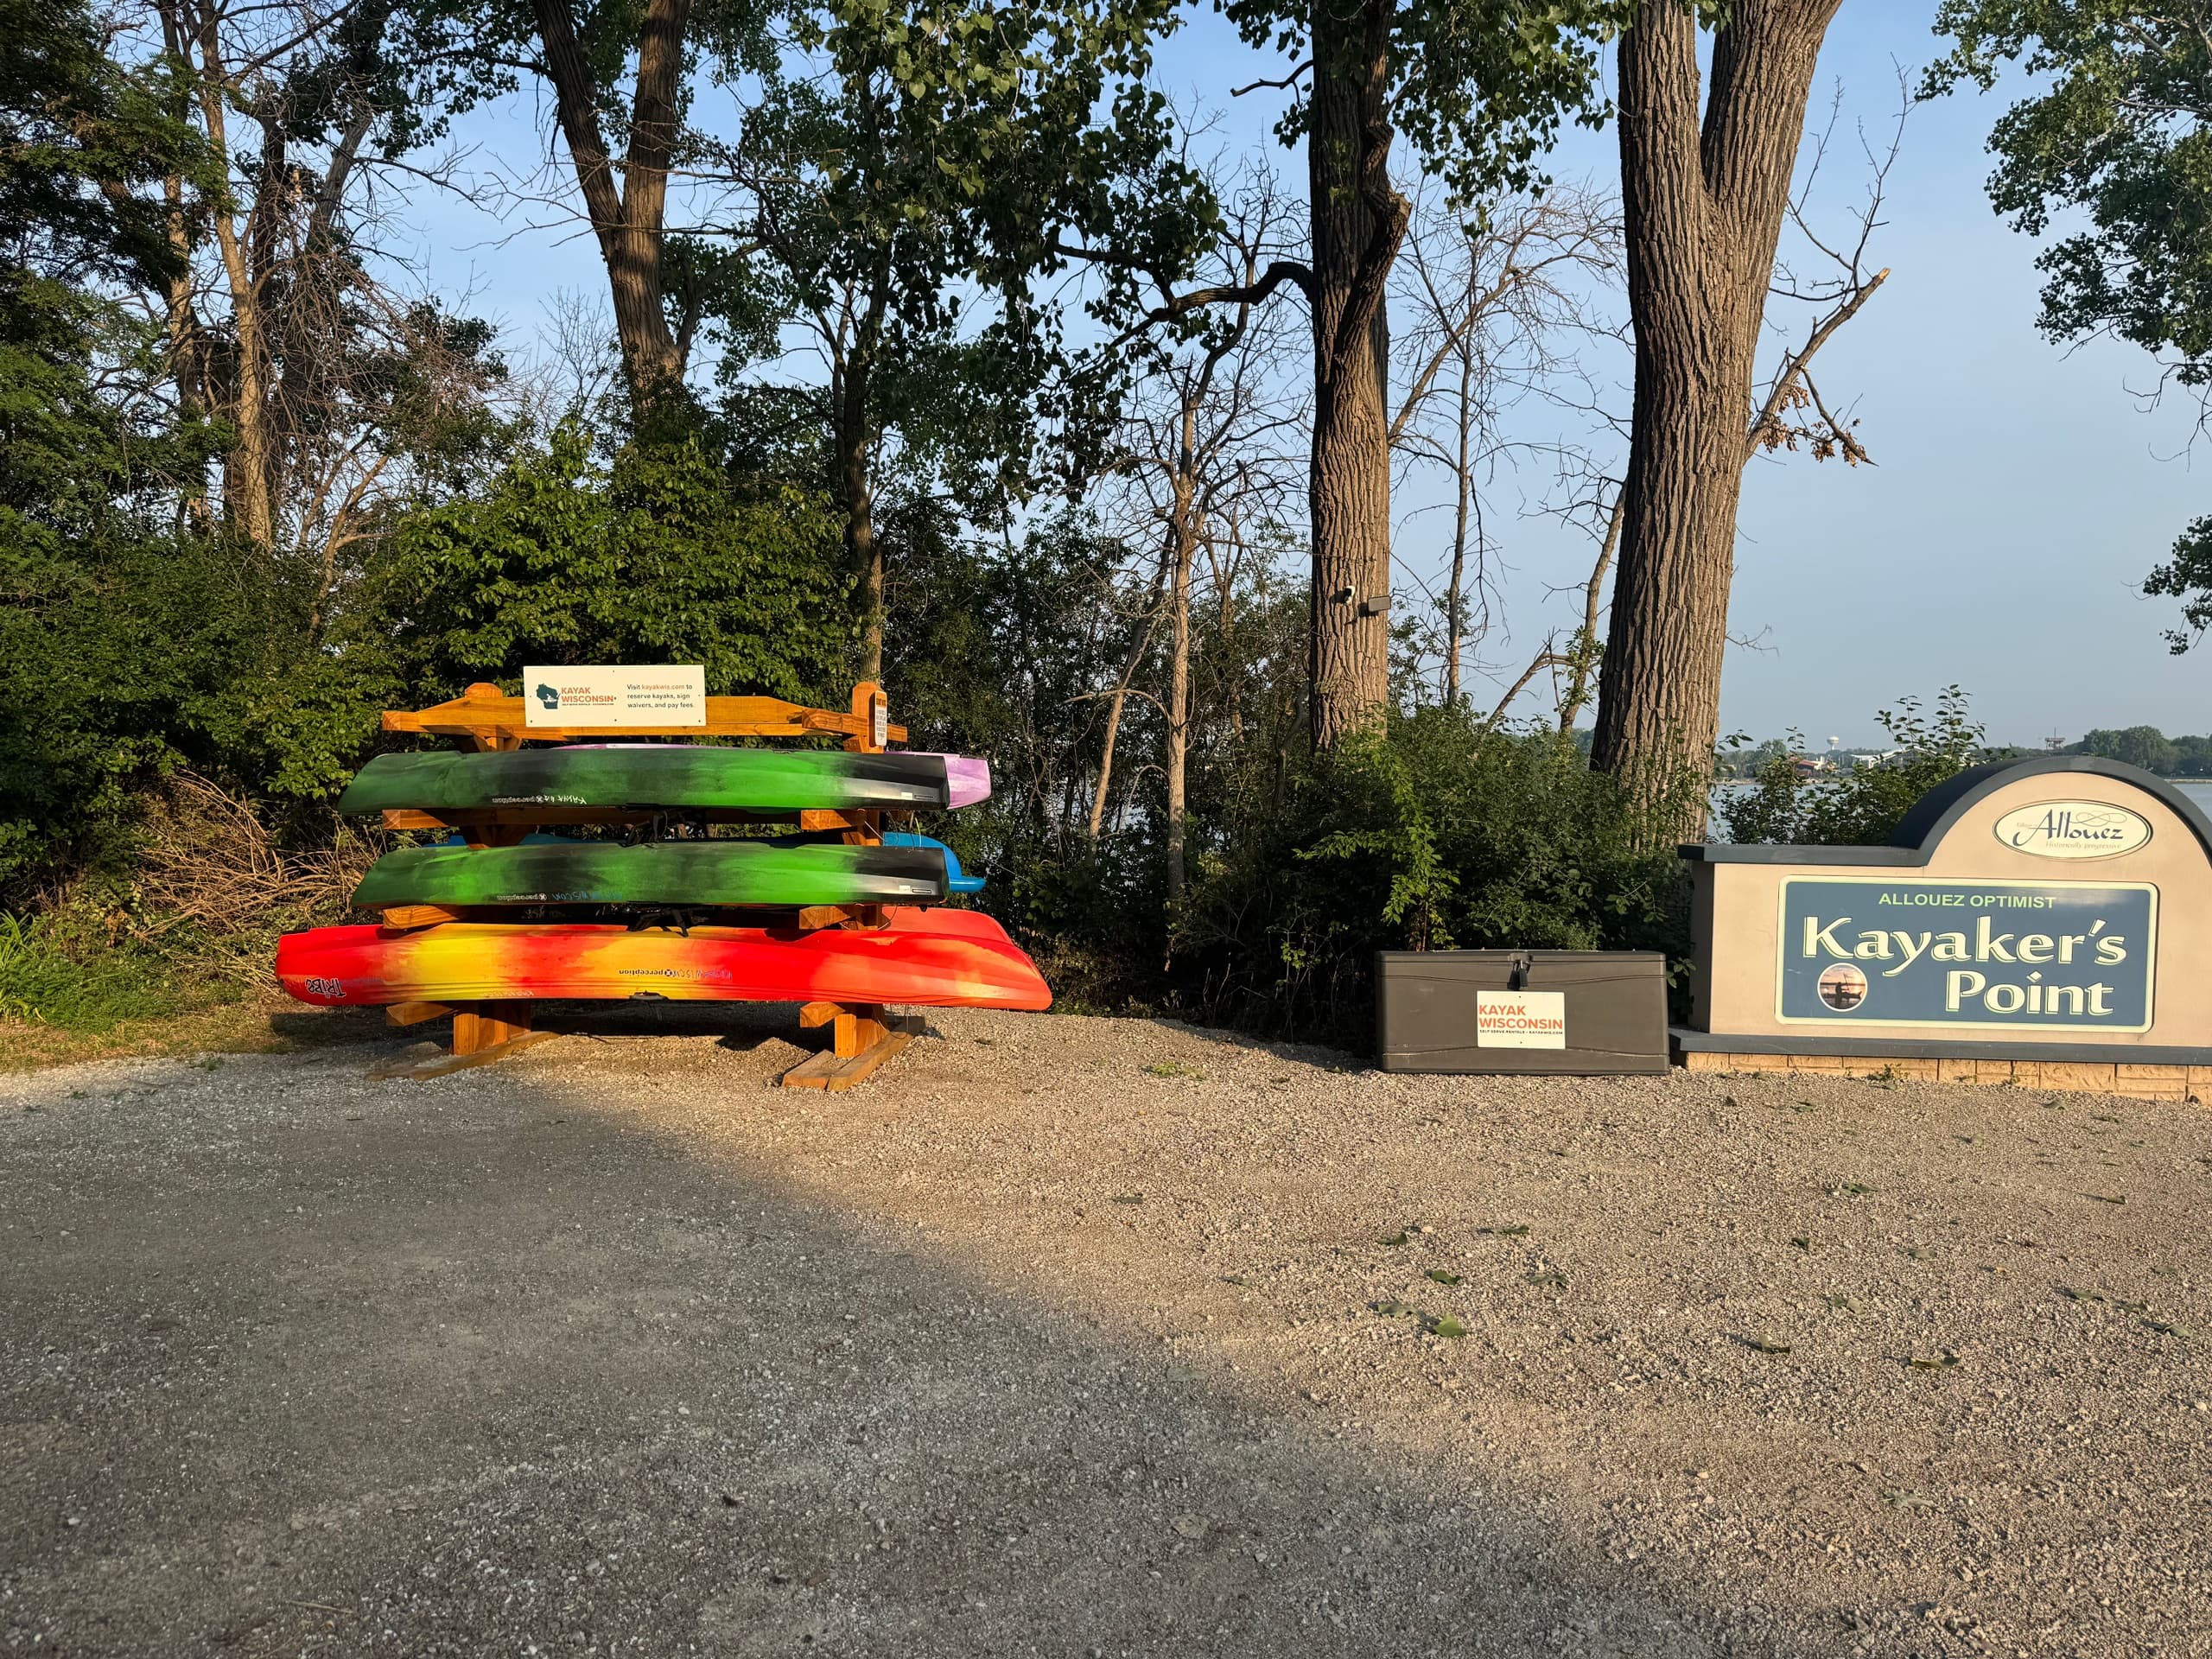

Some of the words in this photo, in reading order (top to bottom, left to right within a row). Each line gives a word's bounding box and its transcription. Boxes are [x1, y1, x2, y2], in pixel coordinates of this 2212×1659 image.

[2012, 808, 2125, 848] Allouez
[1878, 893, 1965, 907] ALLOUEZ
[1969, 894, 2056, 910] OPTIMIST
[1945, 969, 2114, 1017] Point
[1478, 1005, 1526, 1016] KAYAK
[1478, 1017, 1563, 1030] WISCONSIN
